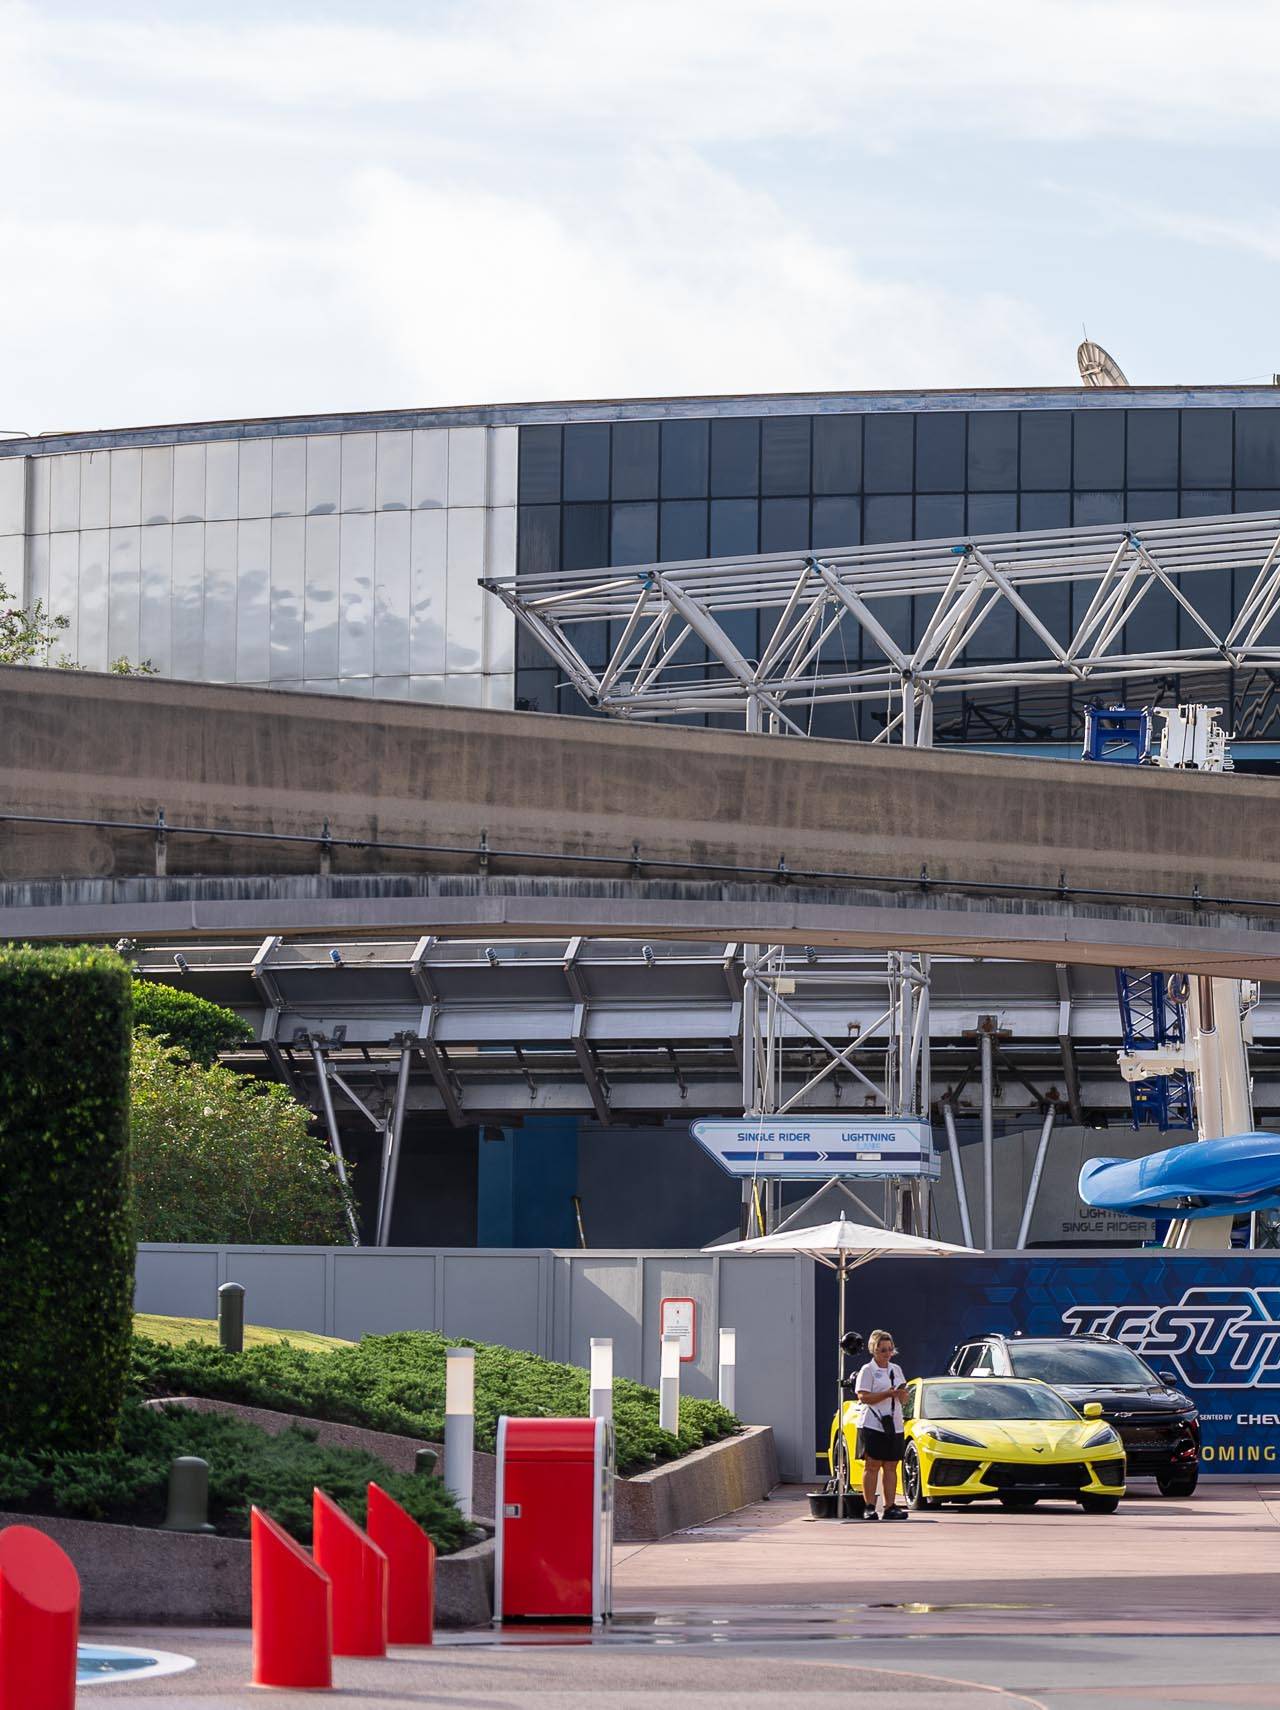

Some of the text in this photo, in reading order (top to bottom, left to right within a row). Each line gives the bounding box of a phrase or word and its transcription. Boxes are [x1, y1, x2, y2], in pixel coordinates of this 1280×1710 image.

[737, 1133, 811, 1142] SINGLE RIDER
[841, 1133, 896, 1142] LIGHTNING
[1062, 1221, 1104, 1233] SINGLE
[1106, 1221, 1147, 1232] RIDER
[1062, 1306, 1251, 1354] TEST
[1199, 1413, 1223, 1421] SENTED
[1223, 1413, 1233, 1421] BY
[1201, 1445, 1277, 1462] OMING
